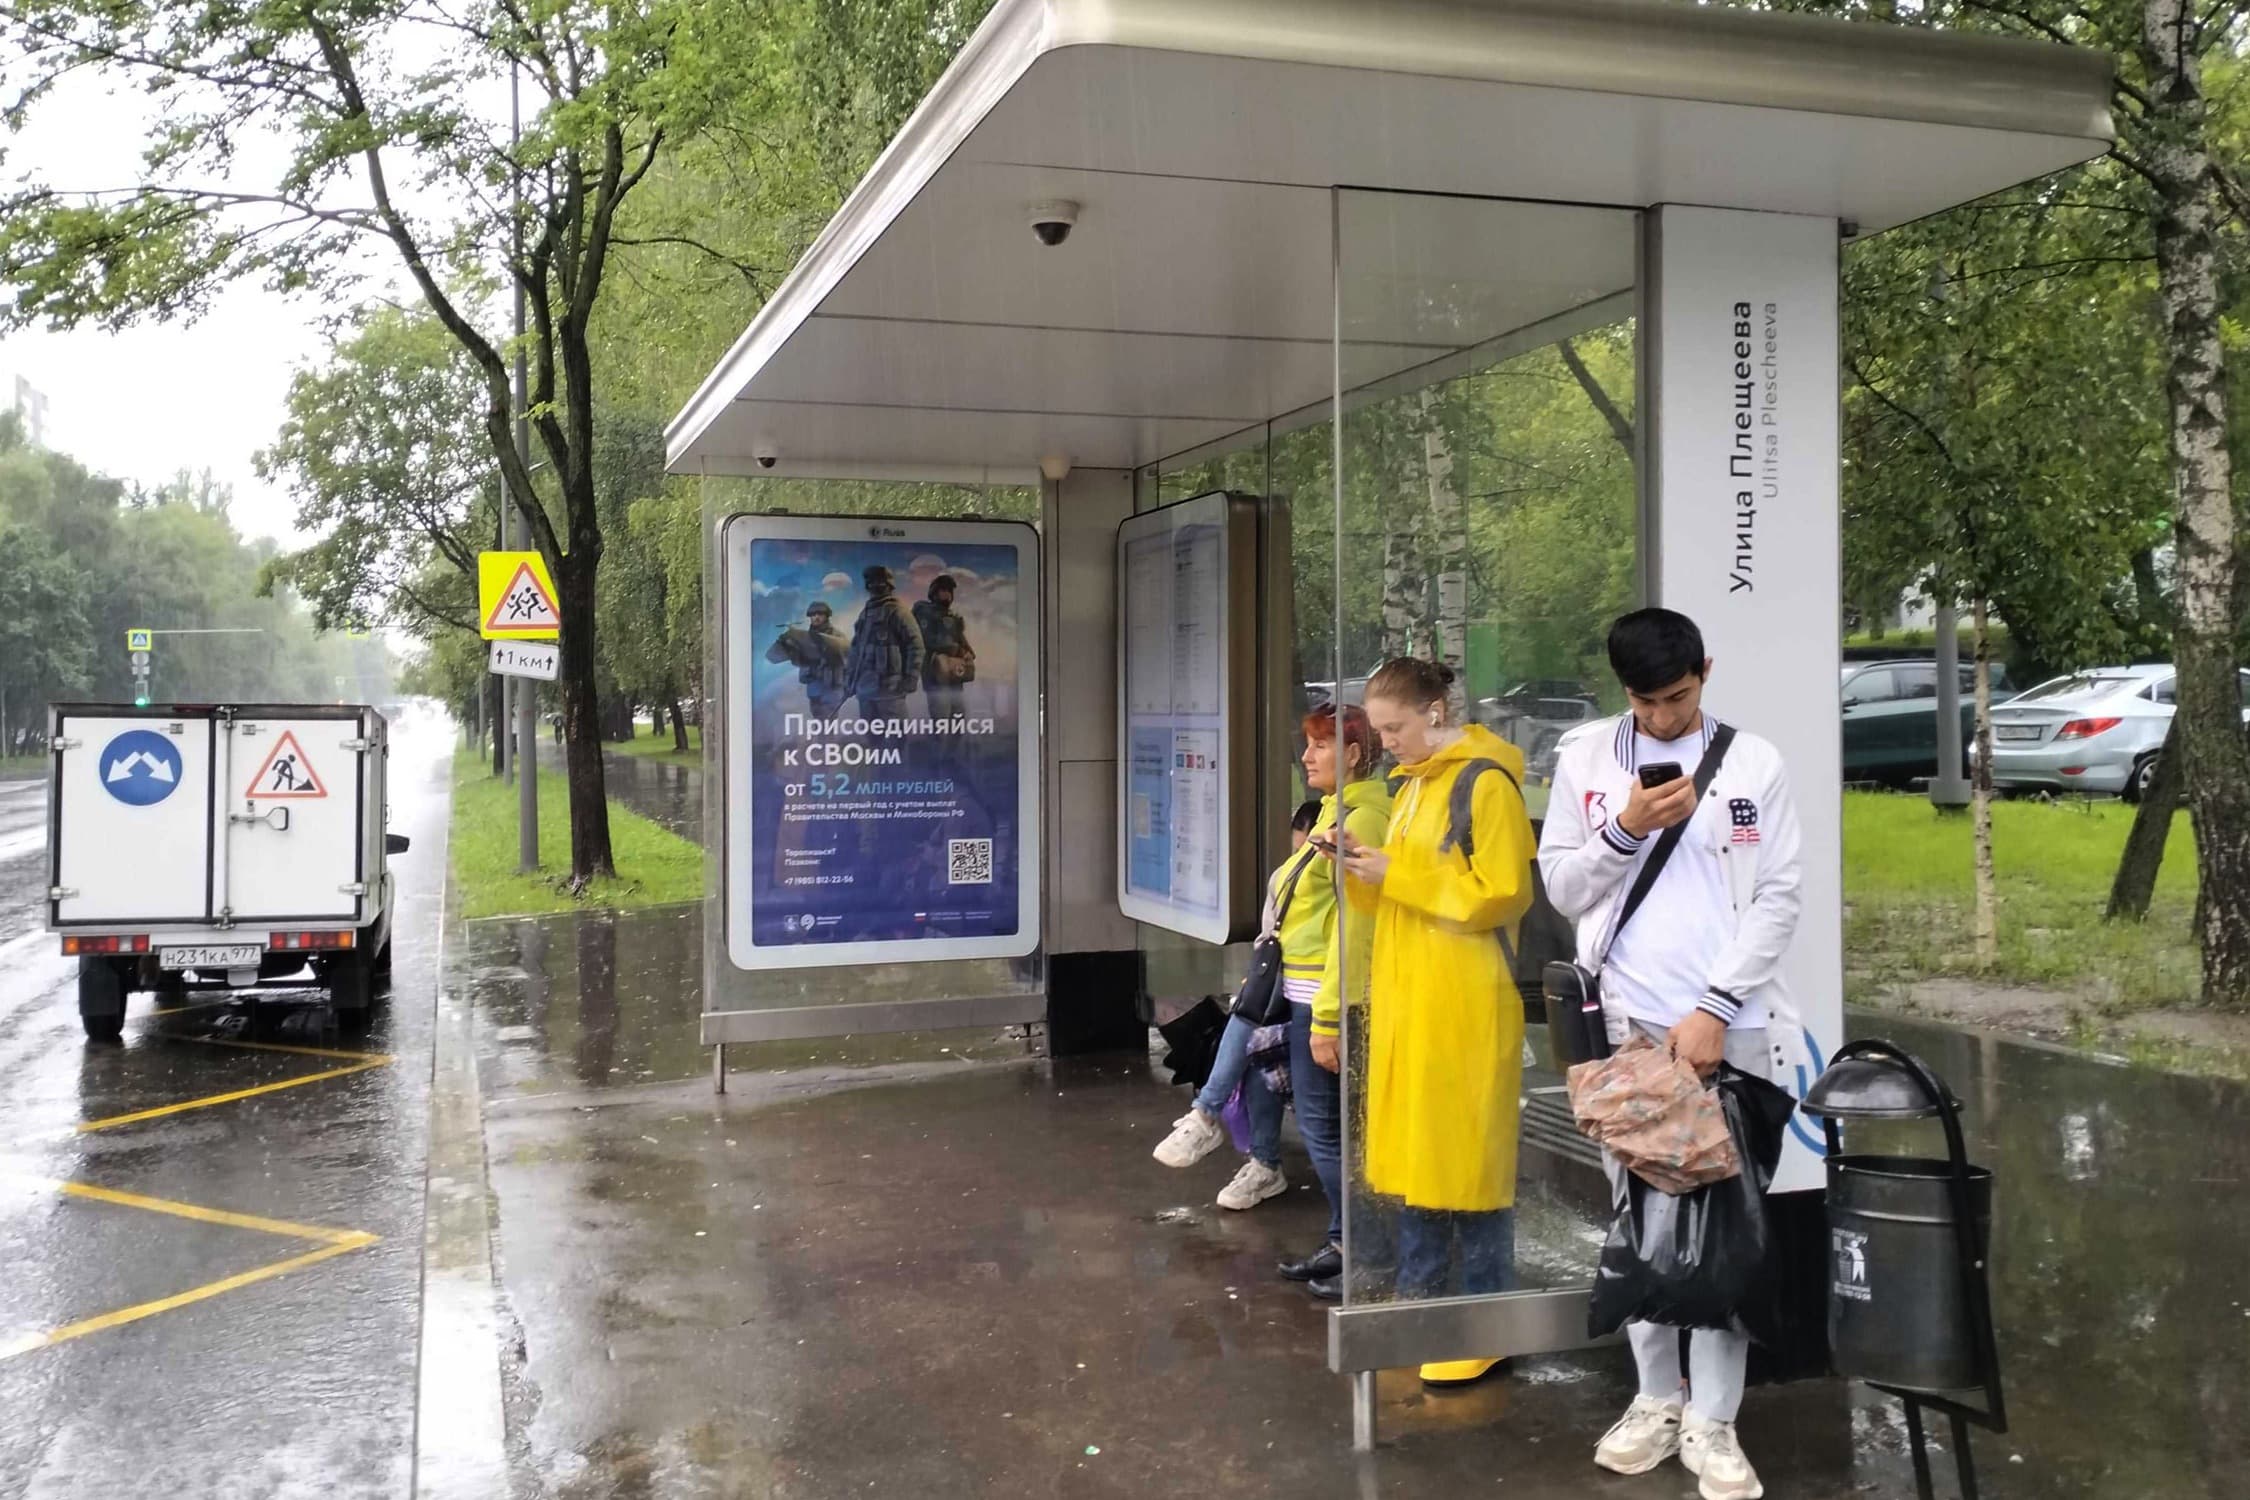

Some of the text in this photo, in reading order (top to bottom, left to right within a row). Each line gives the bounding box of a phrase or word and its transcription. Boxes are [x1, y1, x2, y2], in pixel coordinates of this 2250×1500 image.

[1760, 302, 1778, 498] Ulitsa Plescheeva
[1729, 301, 1757, 592] Улица Плещеева
[784, 713, 995, 740] Присоединяйся
[784, 743, 901, 766] к СВОим
[784, 773, 954, 799] от 5,2 МЛН РУБЛЕЙ
[784, 812, 849, 822] Правительства
[850, 811, 885, 820] Москвы
[893, 810, 950, 820] Минобороны
[951, 809, 965, 818] РФ
[827, 802, 837, 810] на
[839, 800, 871, 810] первый
[873, 801, 888, 810] год
[894, 801, 925, 810] учетом
[926, 801, 957, 809] выплат
